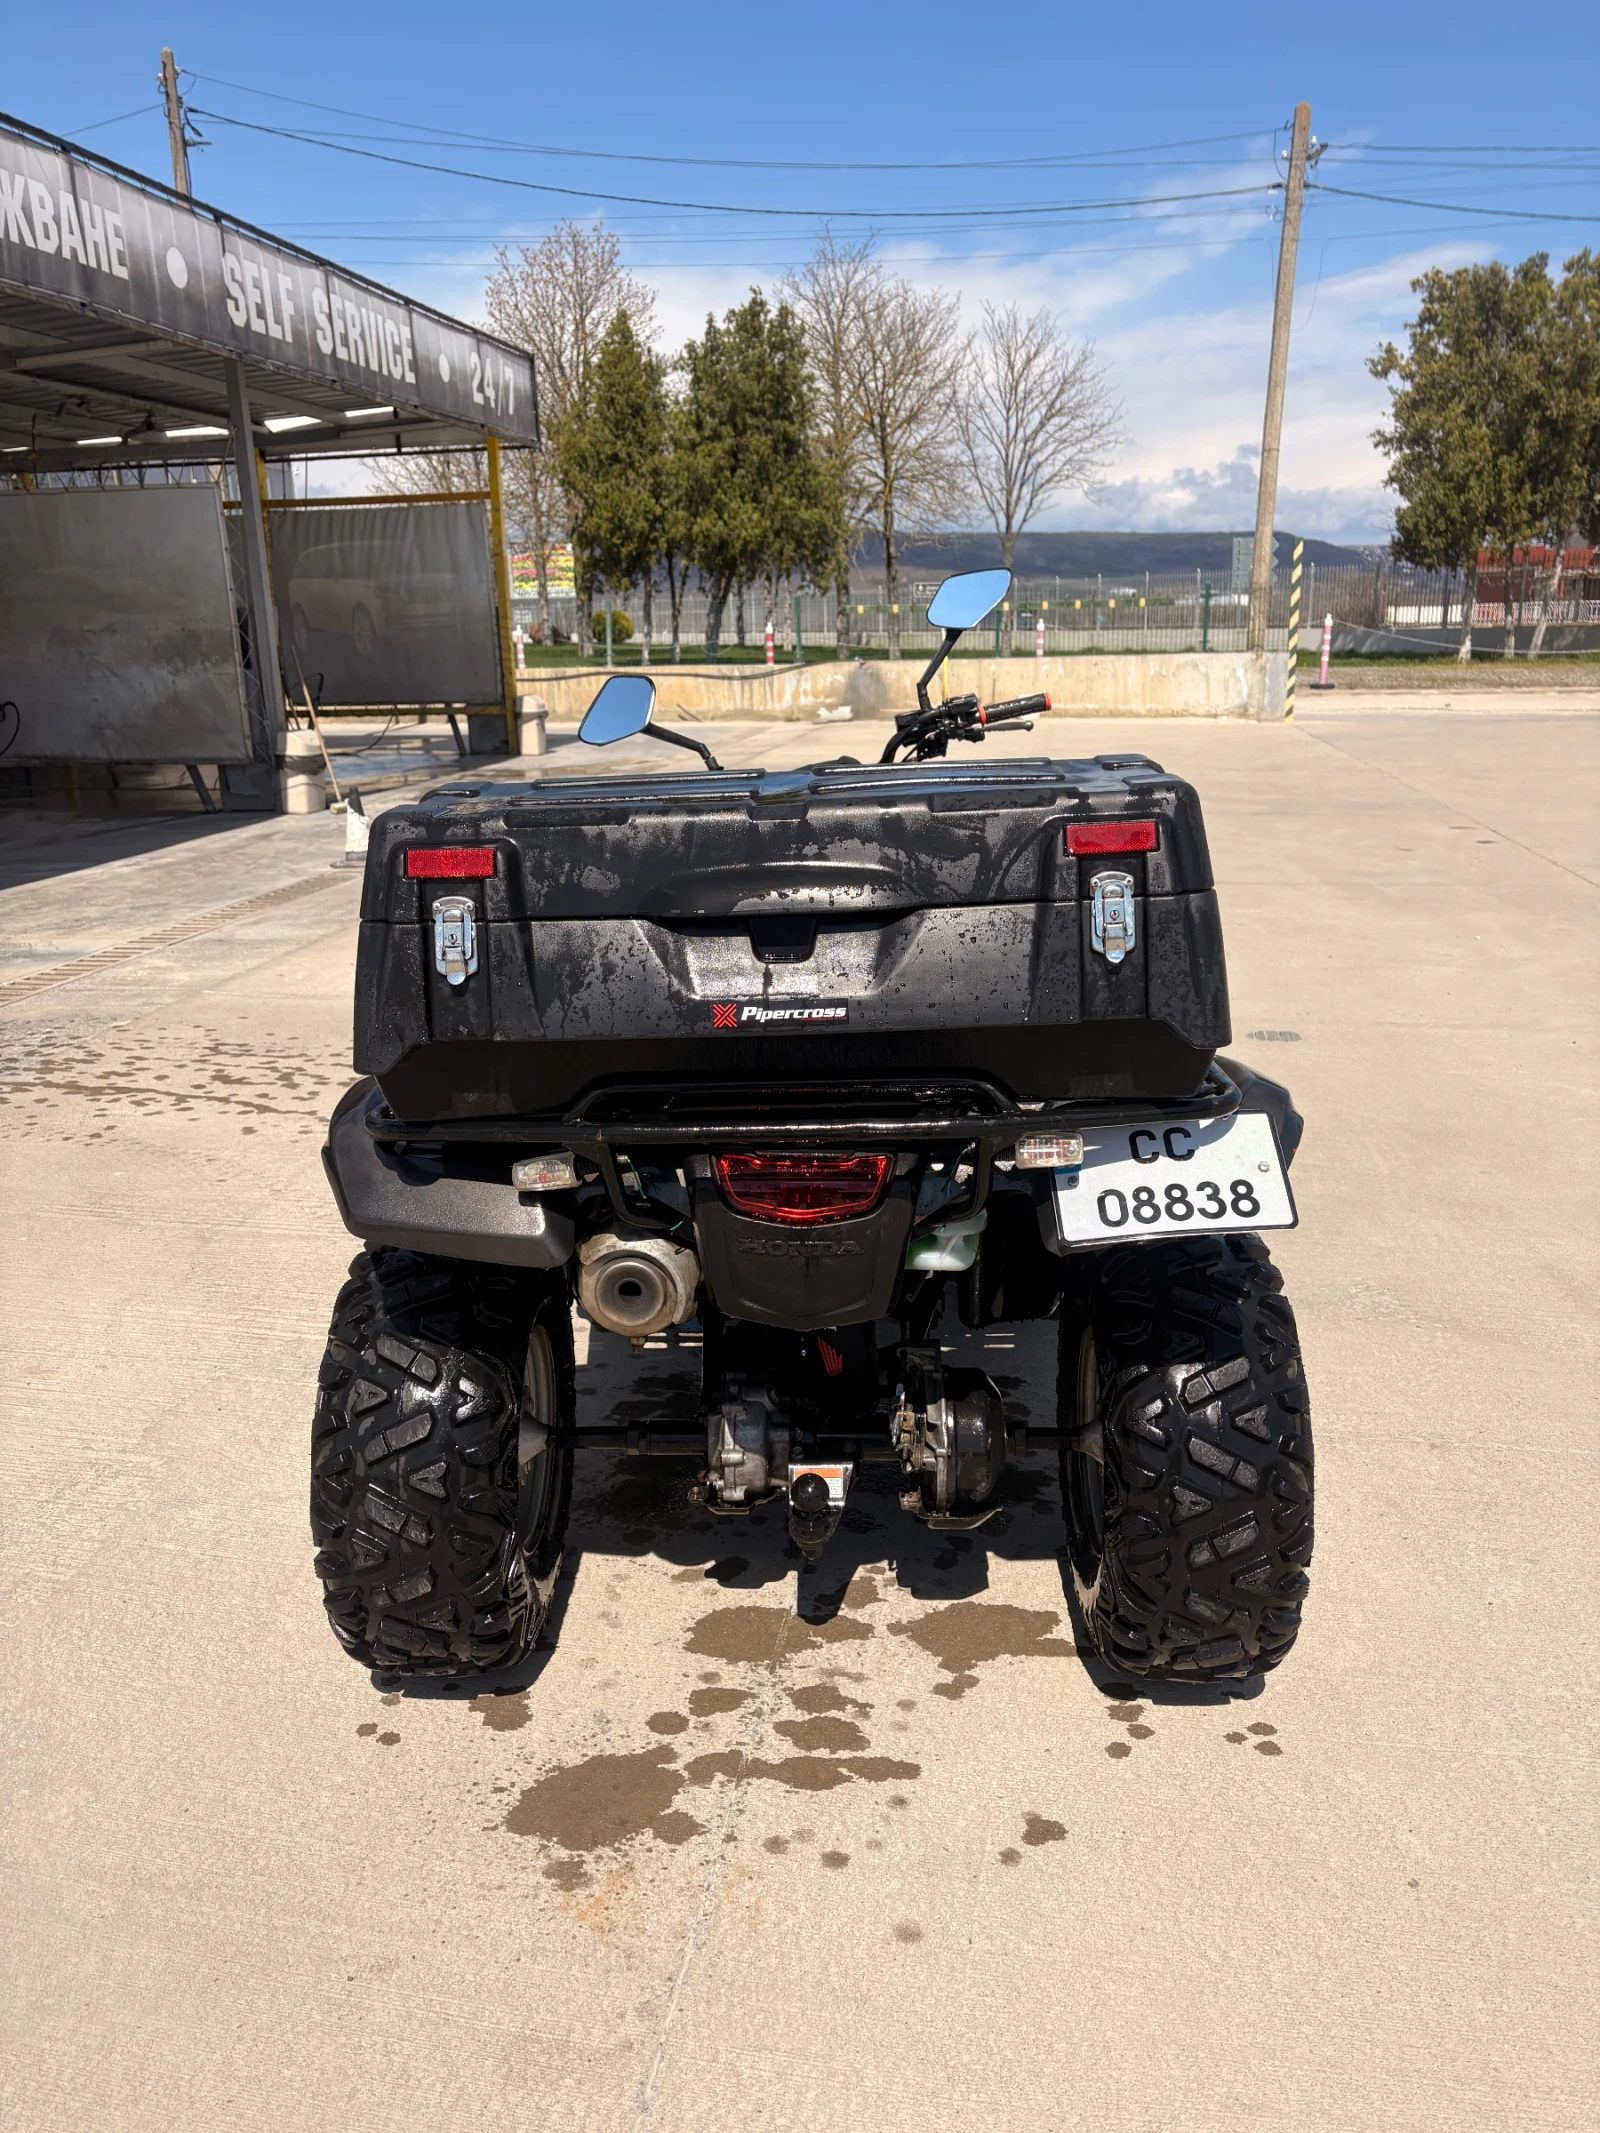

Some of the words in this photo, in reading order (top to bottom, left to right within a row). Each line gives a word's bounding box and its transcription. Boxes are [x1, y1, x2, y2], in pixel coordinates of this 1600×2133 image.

[222, 252, 294, 343] SELF
[311, 287, 416, 384] SERVICE
[470, 351, 514, 416] 24/7
[741, 1006, 847, 1023] Pipercross
[1128, 1127, 1195, 1164] CC
[1096, 1179, 1261, 1227] 08838
[738, 1238, 865, 1257] HONDA
